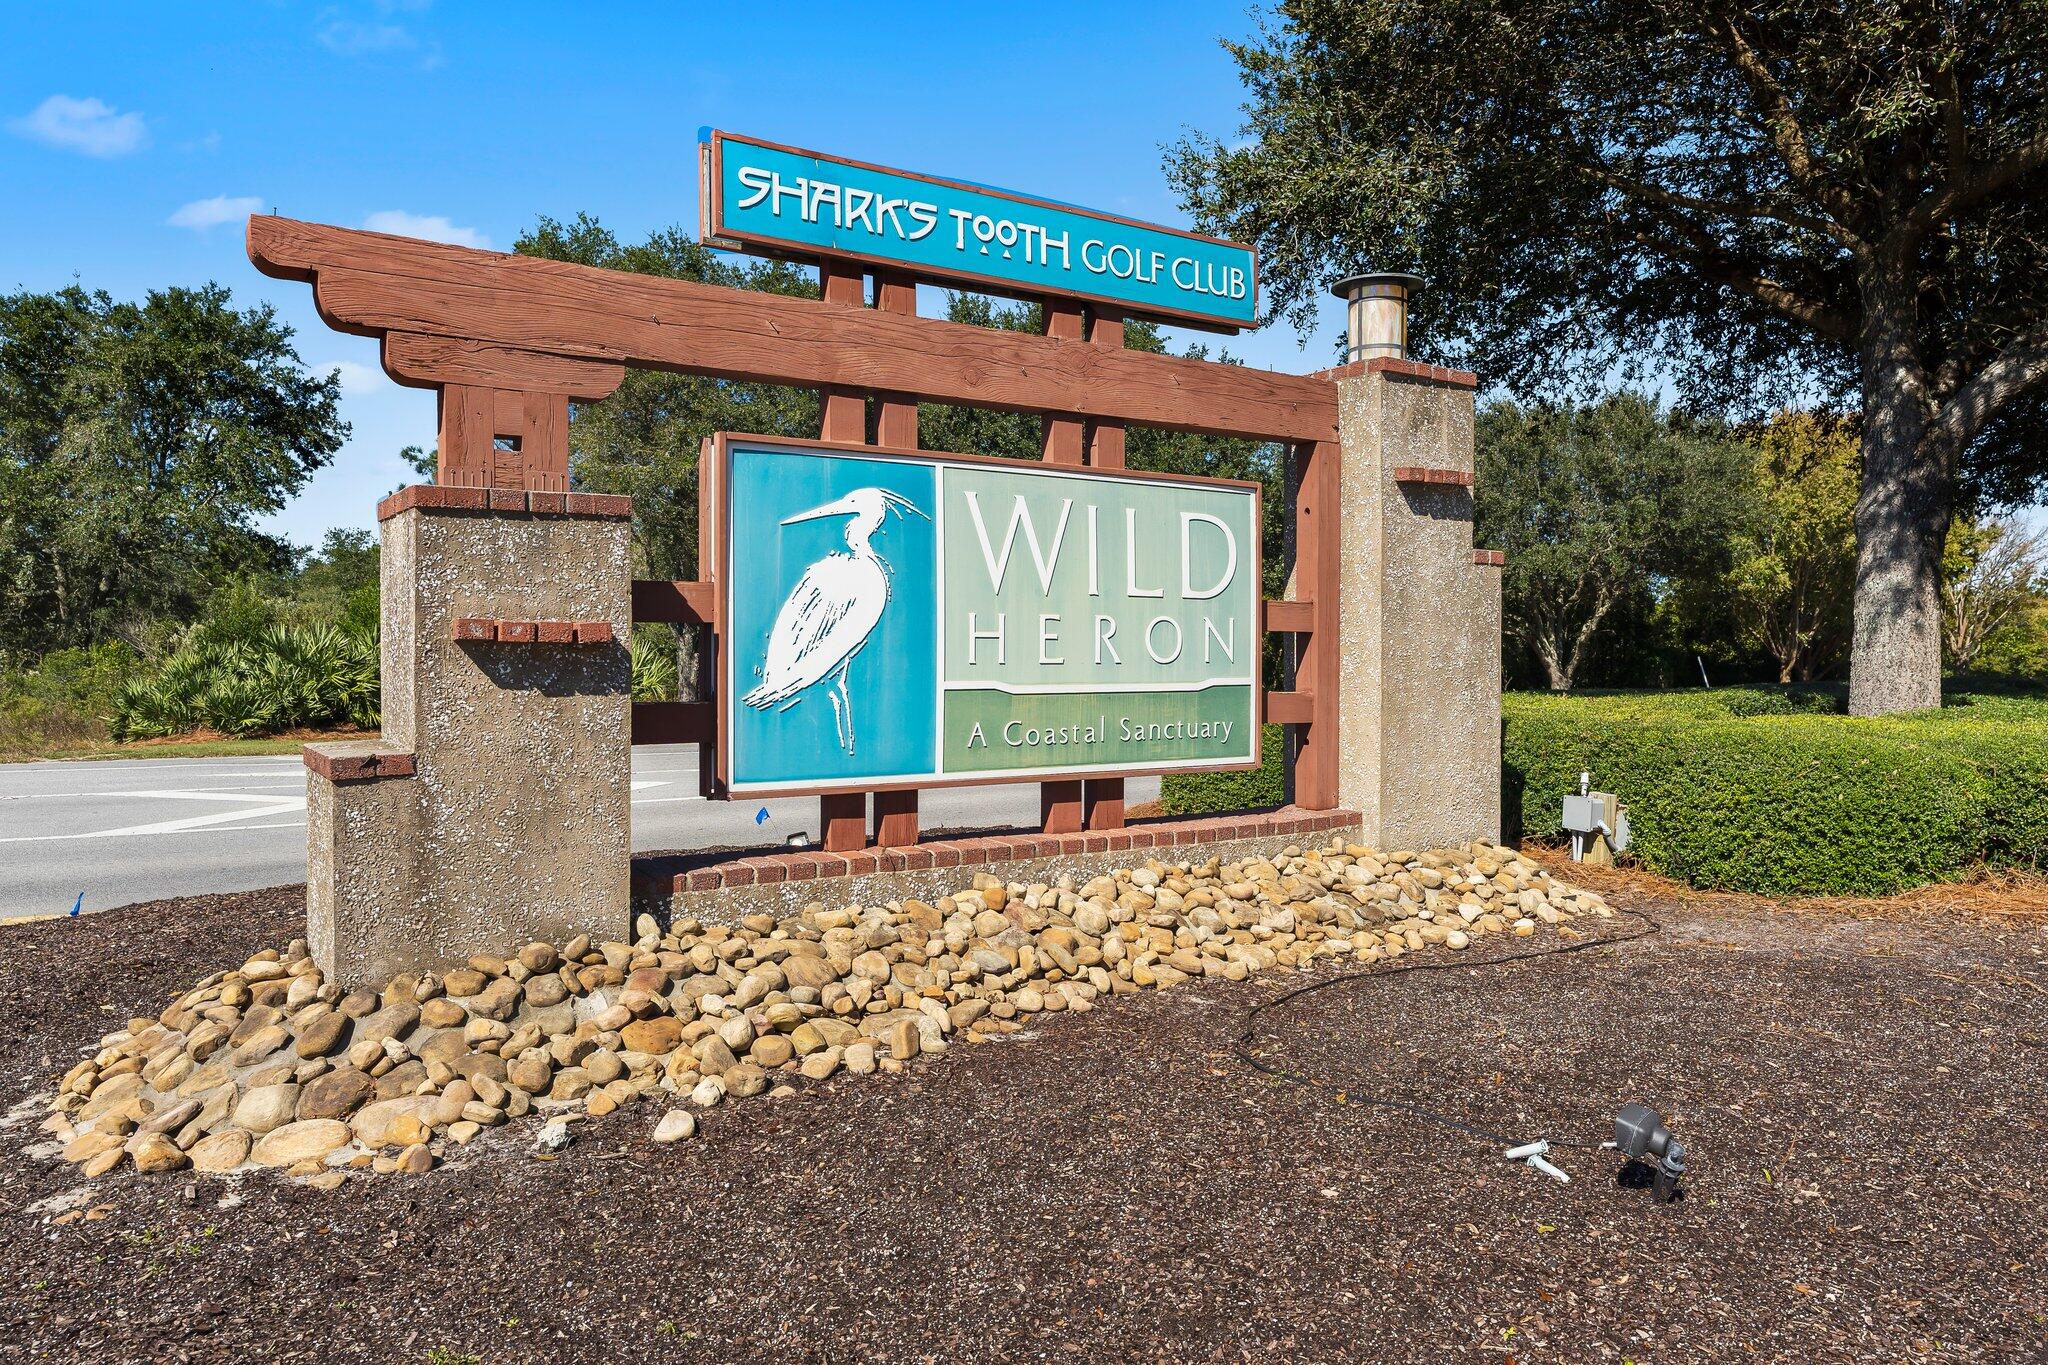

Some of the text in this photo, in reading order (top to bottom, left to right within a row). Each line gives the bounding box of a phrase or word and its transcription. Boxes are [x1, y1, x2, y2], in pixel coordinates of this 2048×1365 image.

[738, 165, 1247, 300] SHARK'S TOOTH GOLF CLUB
[964, 491, 1238, 600] WILD
[968, 612, 1236, 665] HERON
[967, 715, 1234, 749] A Coastal Sanctuary
